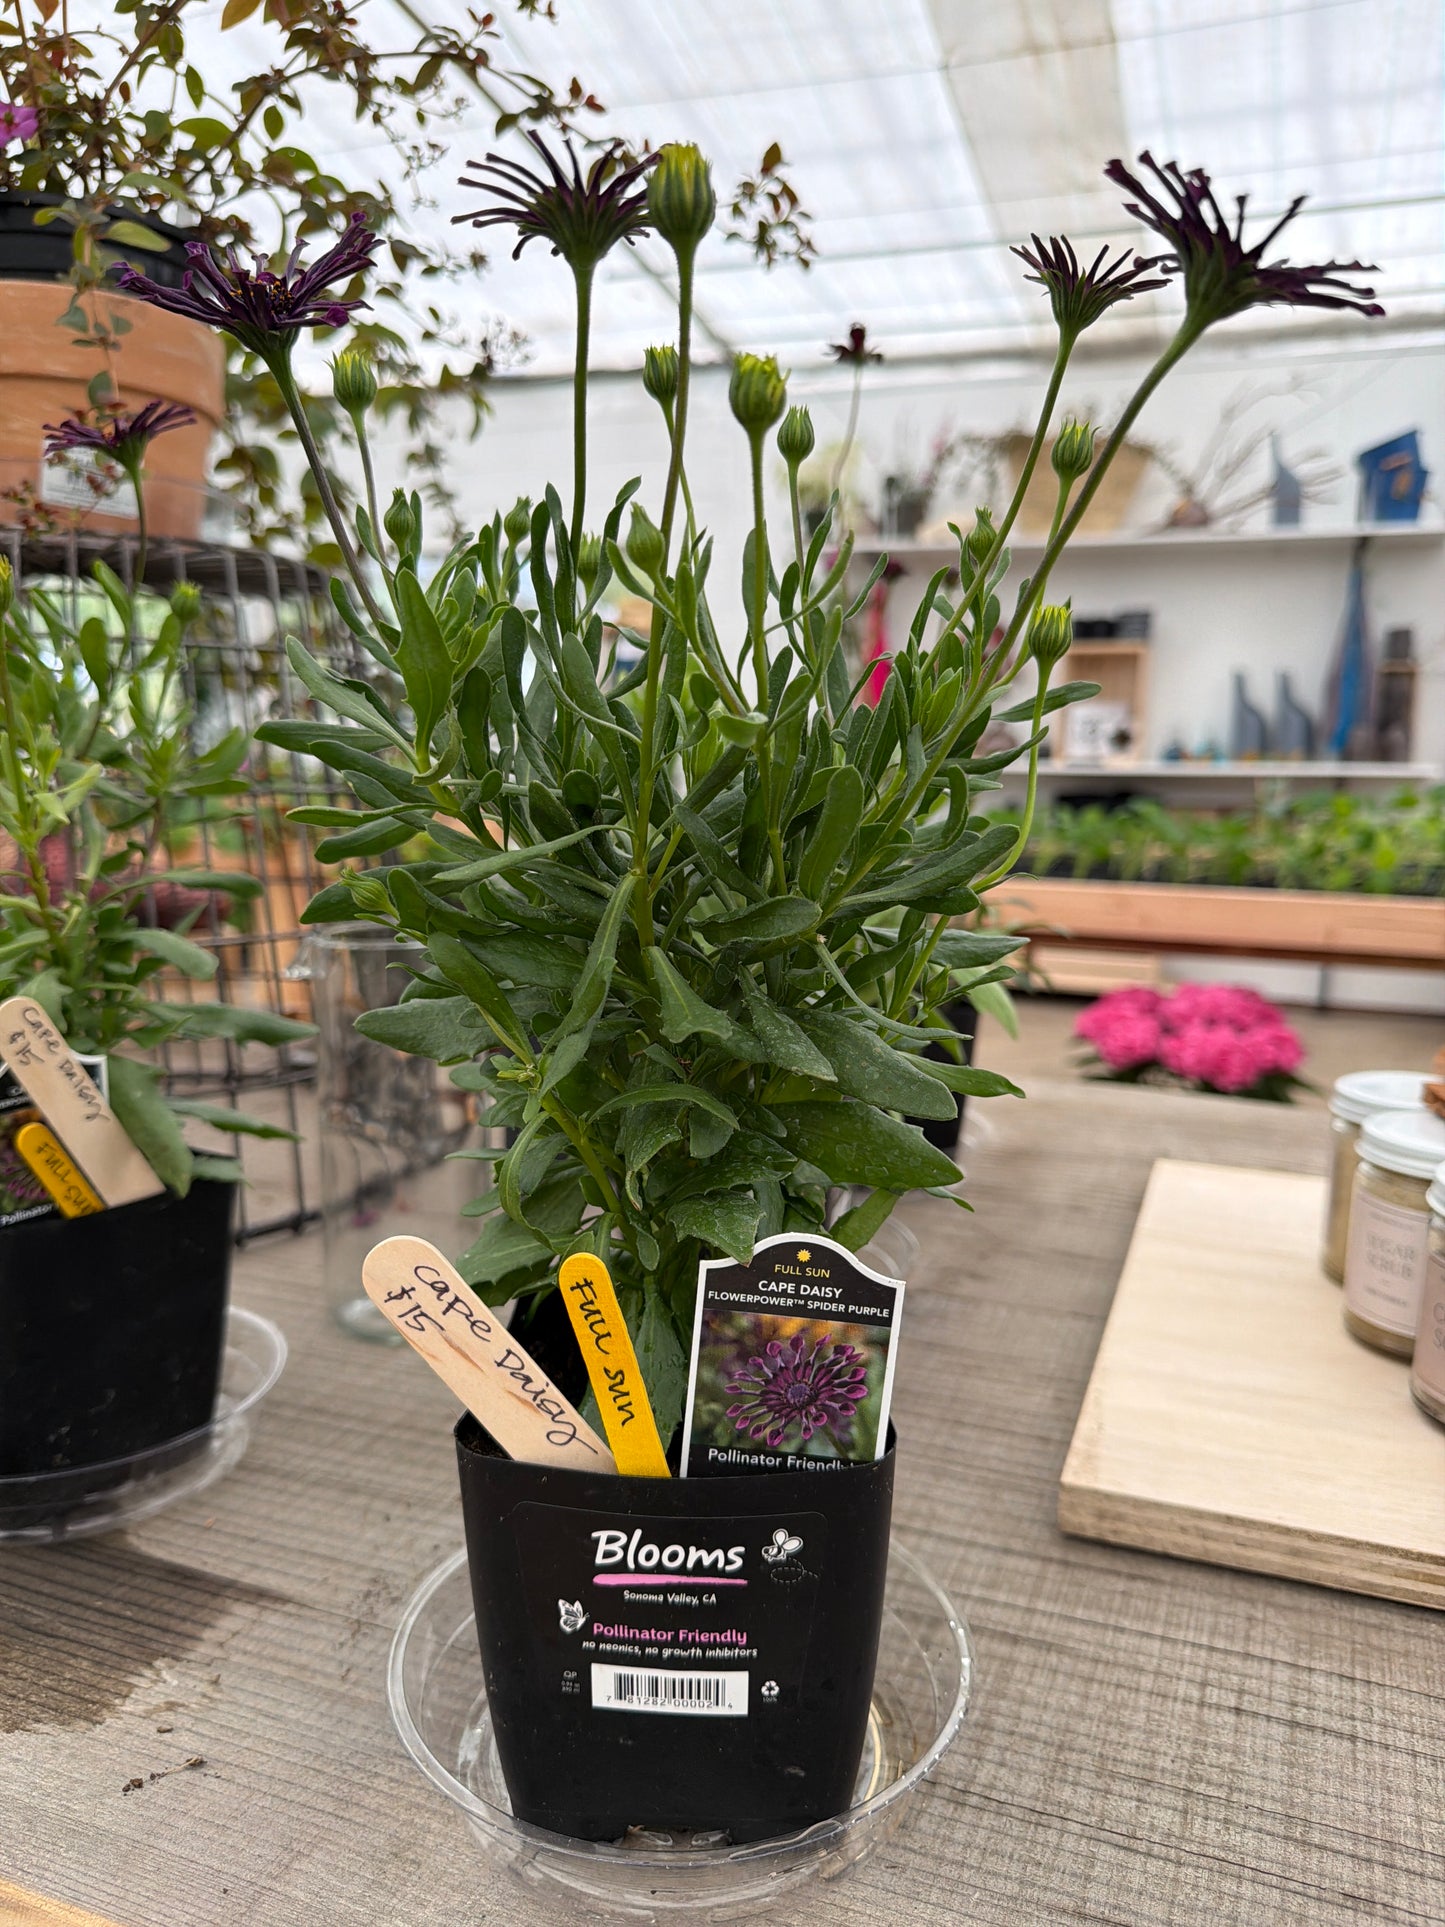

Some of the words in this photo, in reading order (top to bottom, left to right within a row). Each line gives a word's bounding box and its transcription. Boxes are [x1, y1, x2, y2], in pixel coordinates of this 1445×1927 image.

[774, 1264, 802, 1276] FULL
[805, 1267, 830, 1278] SUN
[758, 1280, 796, 1294] CAPE
[800, 1284, 843, 1299] DAISY
[807, 1300, 845, 1313] SPIDER
[848, 1304, 890, 1318] PURPLE
[494, 1348, 598, 1454] Daisy
[708, 1448, 782, 1468] Pollinator
[787, 1456, 848, 1472] Friendl
[591, 1528, 745, 1571] Blooms
[623, 1589, 663, 1602] Sonoma
[667, 1592, 699, 1606] Valley,
[702, 1594, 716, 1604] CA
[593, 1622, 674, 1641] Pollinator
[679, 1628, 747, 1646] Friendly
[582, 1640, 595, 1649] no
[600, 1643, 641, 1655] neonics,
[645, 1646, 658, 1655] no
[662, 1647, 701, 1659] growth
[706, 1648, 758, 1658] inhibitors
[673, 1699, 713, 1709] 00002
